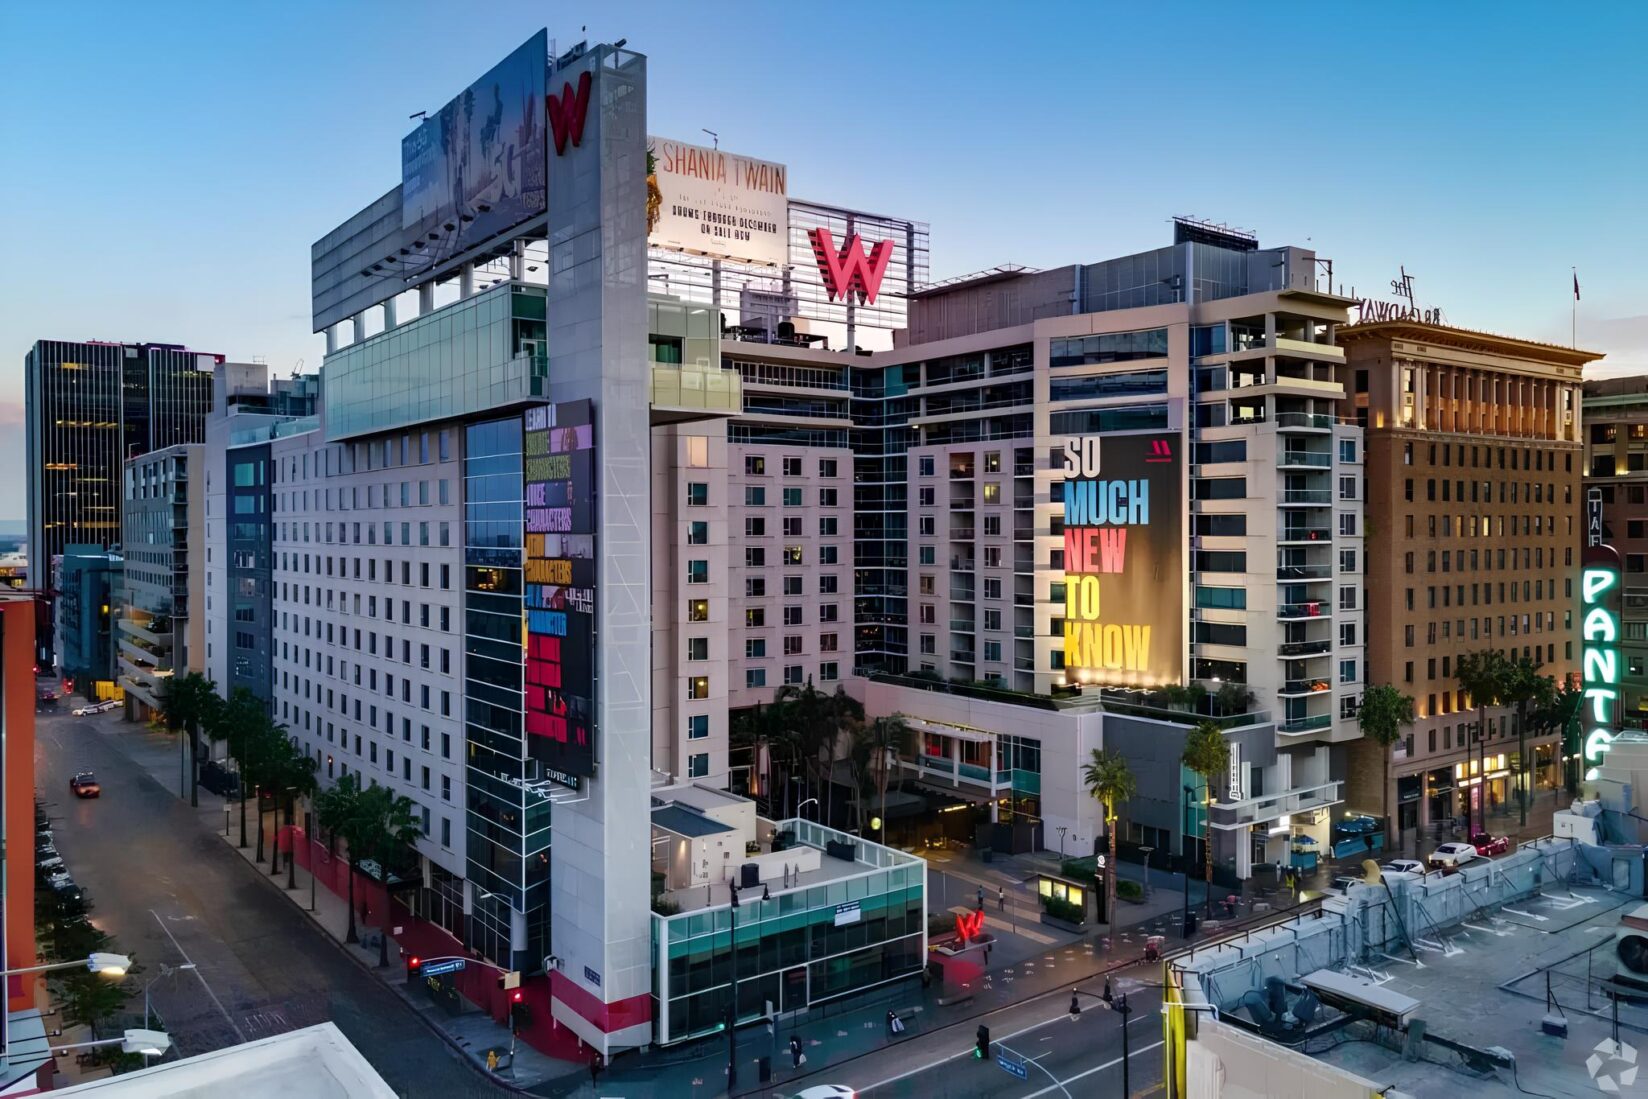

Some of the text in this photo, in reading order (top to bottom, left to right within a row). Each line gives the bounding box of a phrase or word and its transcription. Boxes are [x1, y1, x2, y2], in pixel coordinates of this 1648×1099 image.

[546, 71, 591, 156] W
[663, 142, 786, 195] SHANIA TWAIN
[806, 227, 895, 306] W
[1064, 436, 1101, 479] SO
[1064, 479, 1149, 526] MUCH
[1064, 528, 1127, 573] NEW
[1065, 575, 1100, 620] TO
[1064, 621, 1151, 672] KNOW
[1582, 569, 1616, 781] PANTA
[956, 909, 985, 941] W
